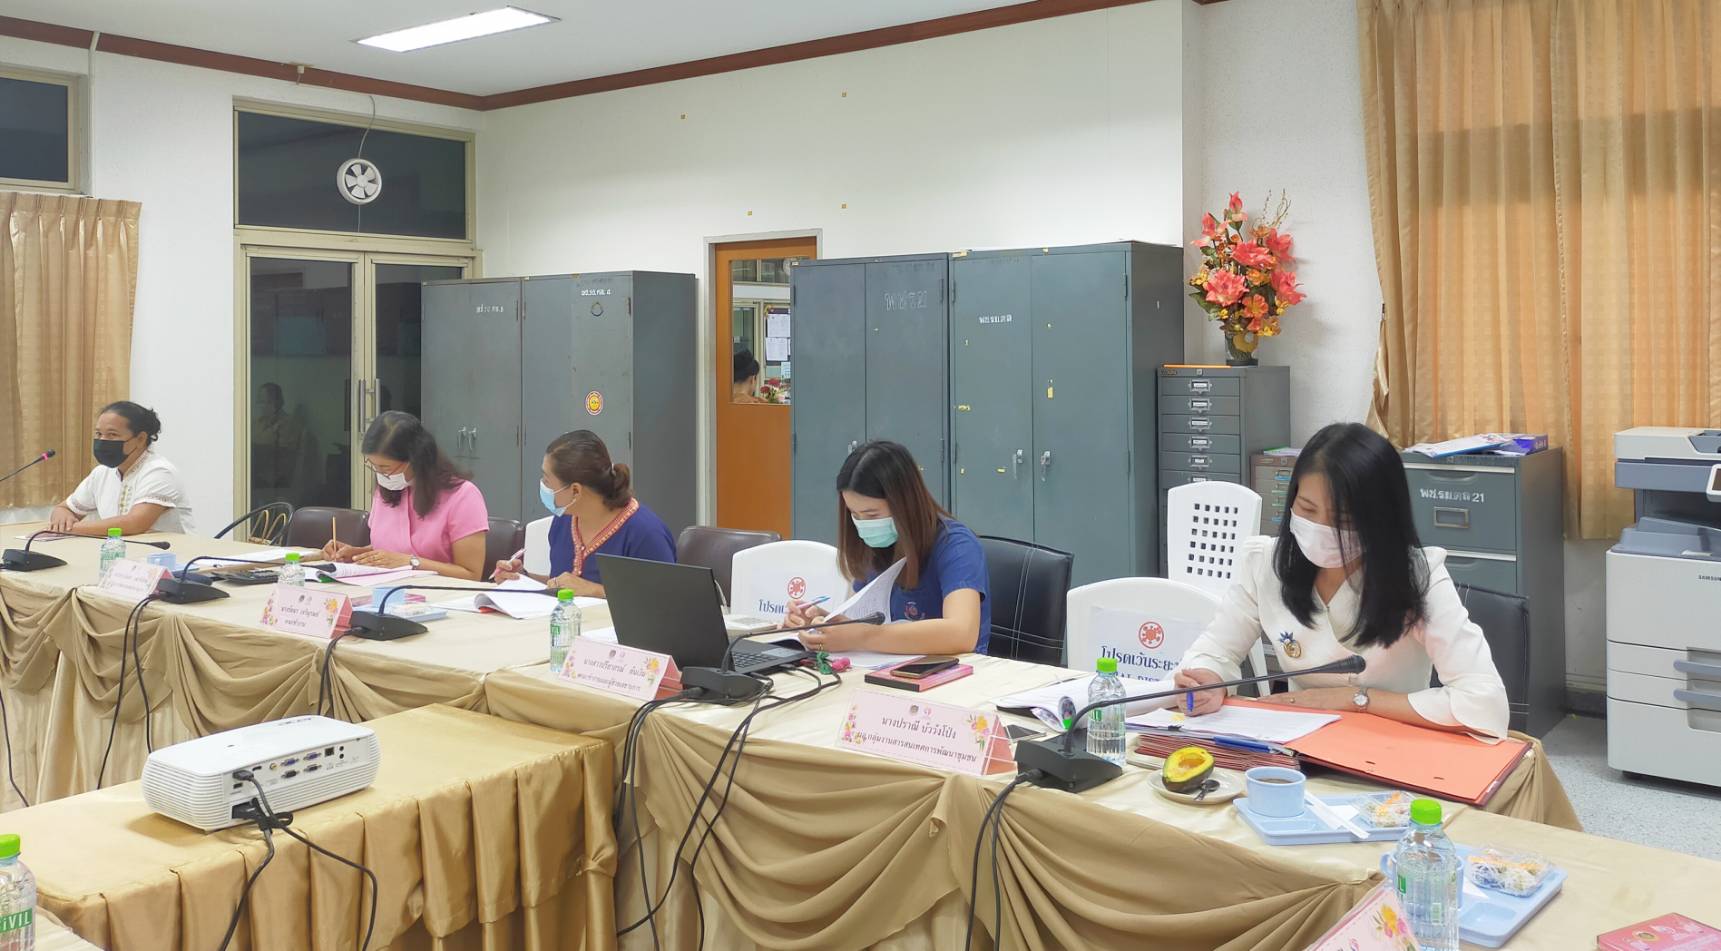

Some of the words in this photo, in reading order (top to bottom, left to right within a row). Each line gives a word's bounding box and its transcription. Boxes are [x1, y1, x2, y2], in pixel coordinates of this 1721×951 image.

[1101, 645, 1180, 672] โปรดเว้นระยะ
[0, 911, 30, 931] iVIL
